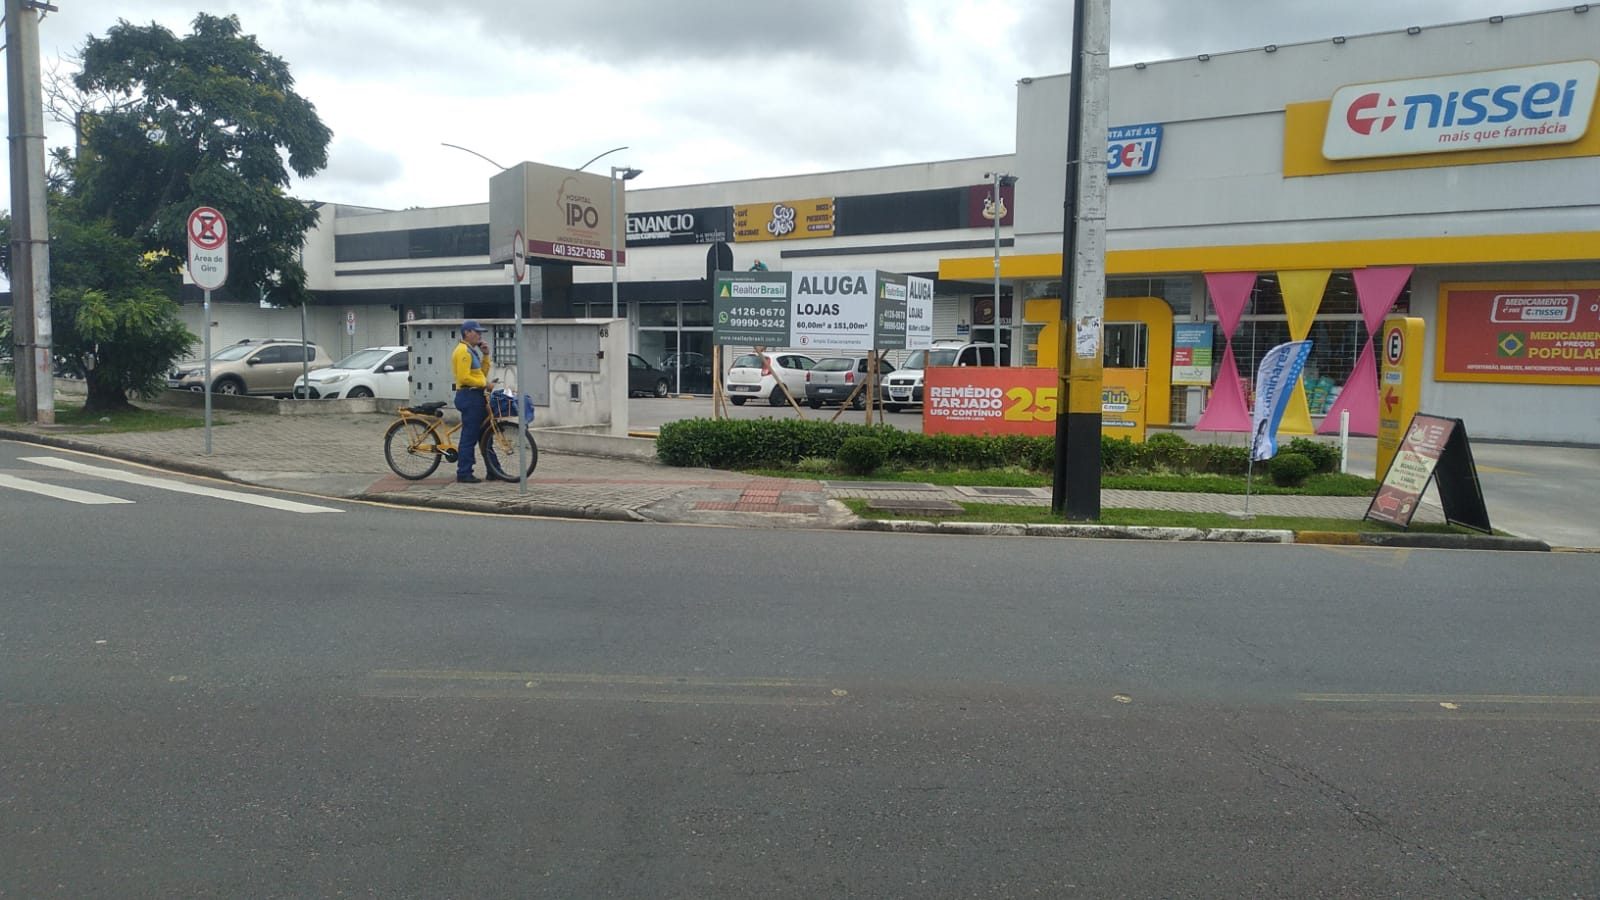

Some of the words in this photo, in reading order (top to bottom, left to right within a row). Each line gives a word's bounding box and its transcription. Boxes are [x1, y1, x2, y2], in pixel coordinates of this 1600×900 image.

[1403, 79, 1578, 130] nissei
[1125, 127, 1142, 137] ATÉ
[1144, 127, 1157, 135] AS
[1438, 131, 1470, 143] mais
[1473, 129, 1500, 143] que
[1504, 122, 1567, 137] farmácia
[566, 195, 592, 204] HOSPITAL
[566, 203, 599, 229] IPO
[625, 213, 694, 233] ENANCIO
[552, 243, 566, 256] (41)
[567, 246, 606, 260] 3527-0396
[200, 264, 217, 272] Giro
[733, 284, 785, 295] RealtorBrasil
[797, 276, 868, 295] ALUGA
[909, 280, 932, 300] ALUGA
[1505, 298, 1569, 306] MEDICAMENTO
[730, 307, 786, 316] 4126-0670
[797, 303, 840, 315] LOJAS
[908, 307, 924, 319] LOJAS
[1535, 308, 1564, 316] nissei
[730, 318, 785, 328] 99990-5242
[797, 321, 826, 330] 60,00m²
[833, 322, 868, 331] 151,00m²
[600, 328, 609, 338] 68
[1391, 335, 1399, 359] E
[930, 384, 1003, 398] REMÉDIO
[930, 398, 1003, 409] TARJADO
[1004, 387, 1057, 421] 25
[951, 409, 1002, 417] CONTÍNUO
